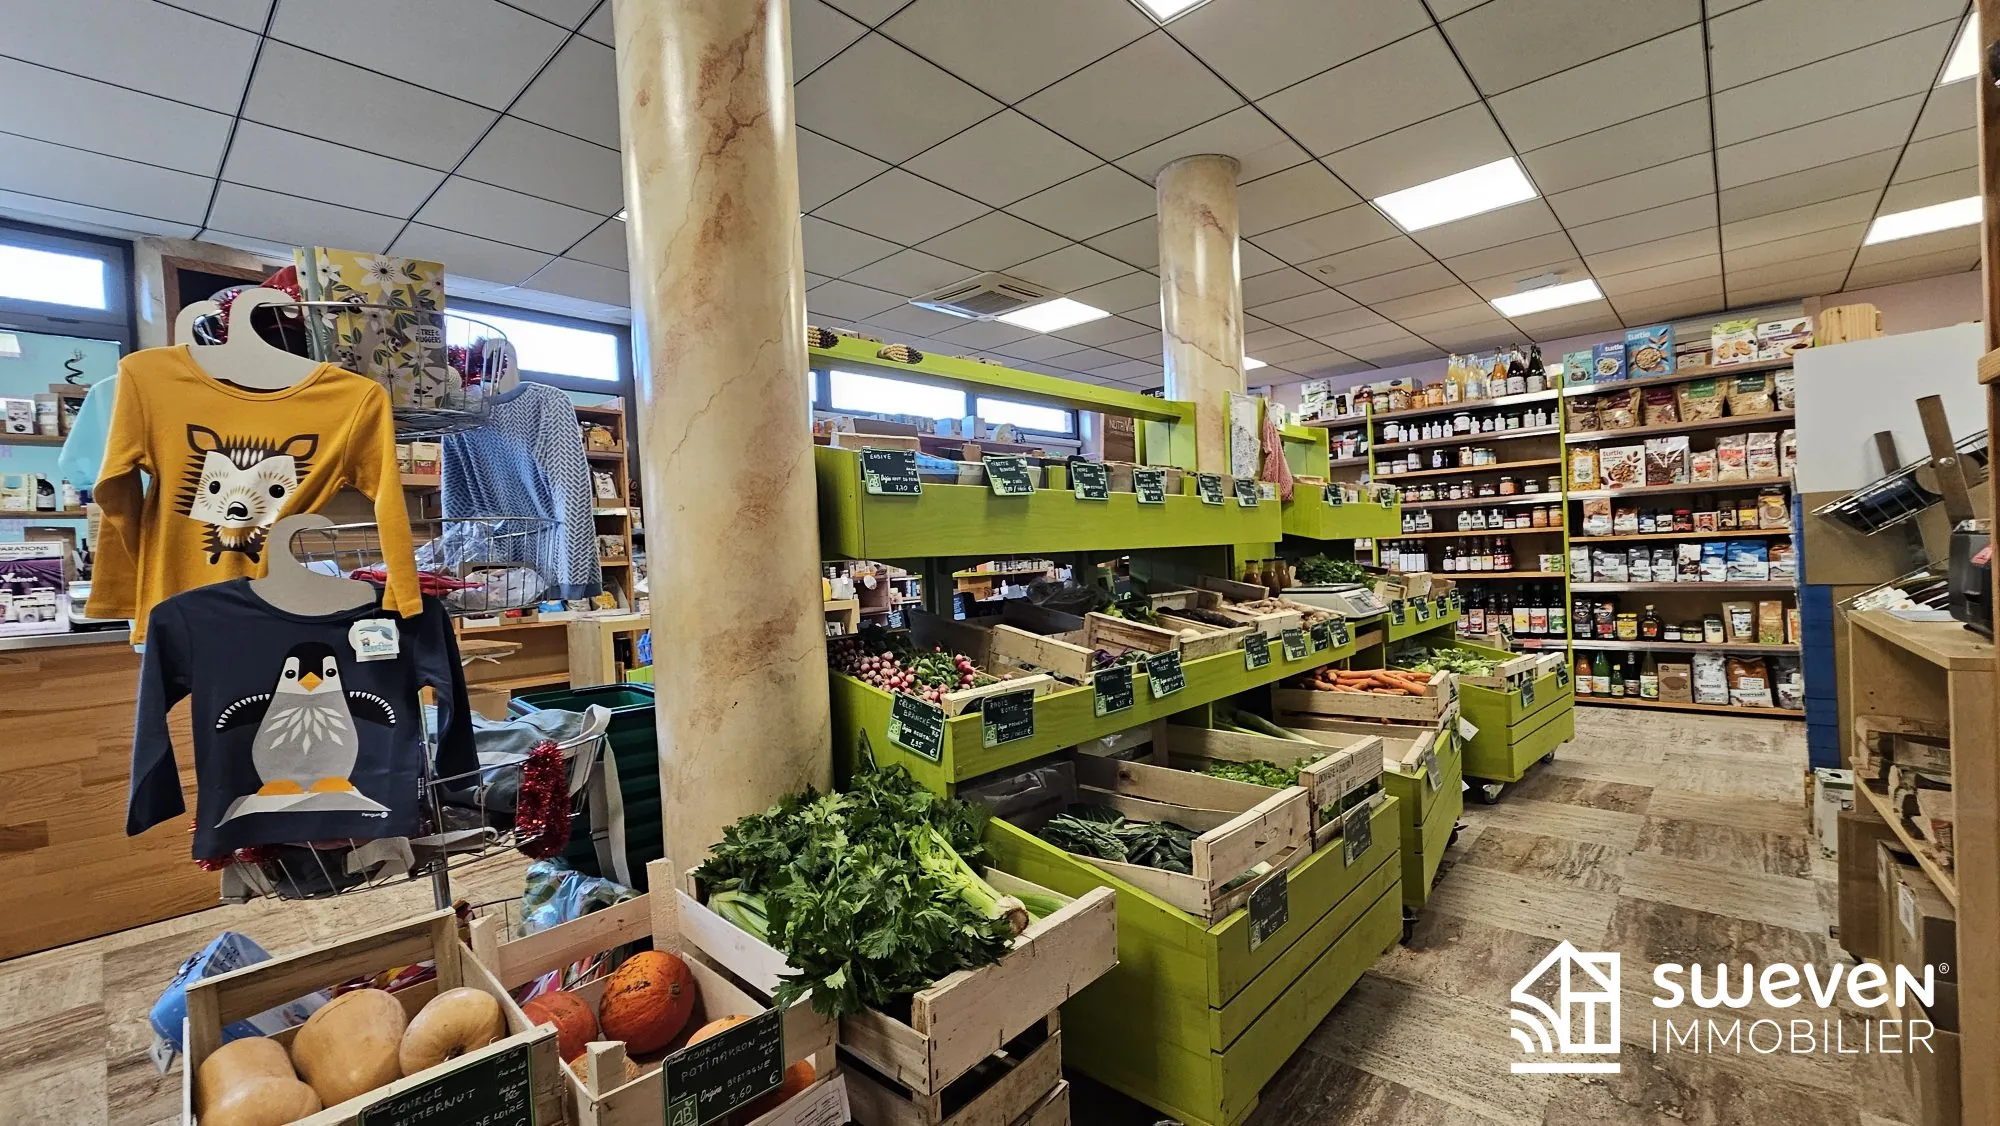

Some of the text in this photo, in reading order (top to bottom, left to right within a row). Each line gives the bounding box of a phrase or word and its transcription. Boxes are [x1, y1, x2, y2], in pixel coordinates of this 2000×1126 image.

[913, 484, 920, 493] €
[1027, 726, 1034, 736] €
[929, 747, 937, 758] €
[687, 1037, 727, 1061] COURGE
[681, 1038, 756, 1083] POTIMARRON
[728, 1070, 780, 1106] 3,60 €
[391, 1086, 444, 1116] COURGE
[493, 1099, 525, 1121] LOIRE
[672, 1106, 693, 1126] AB
